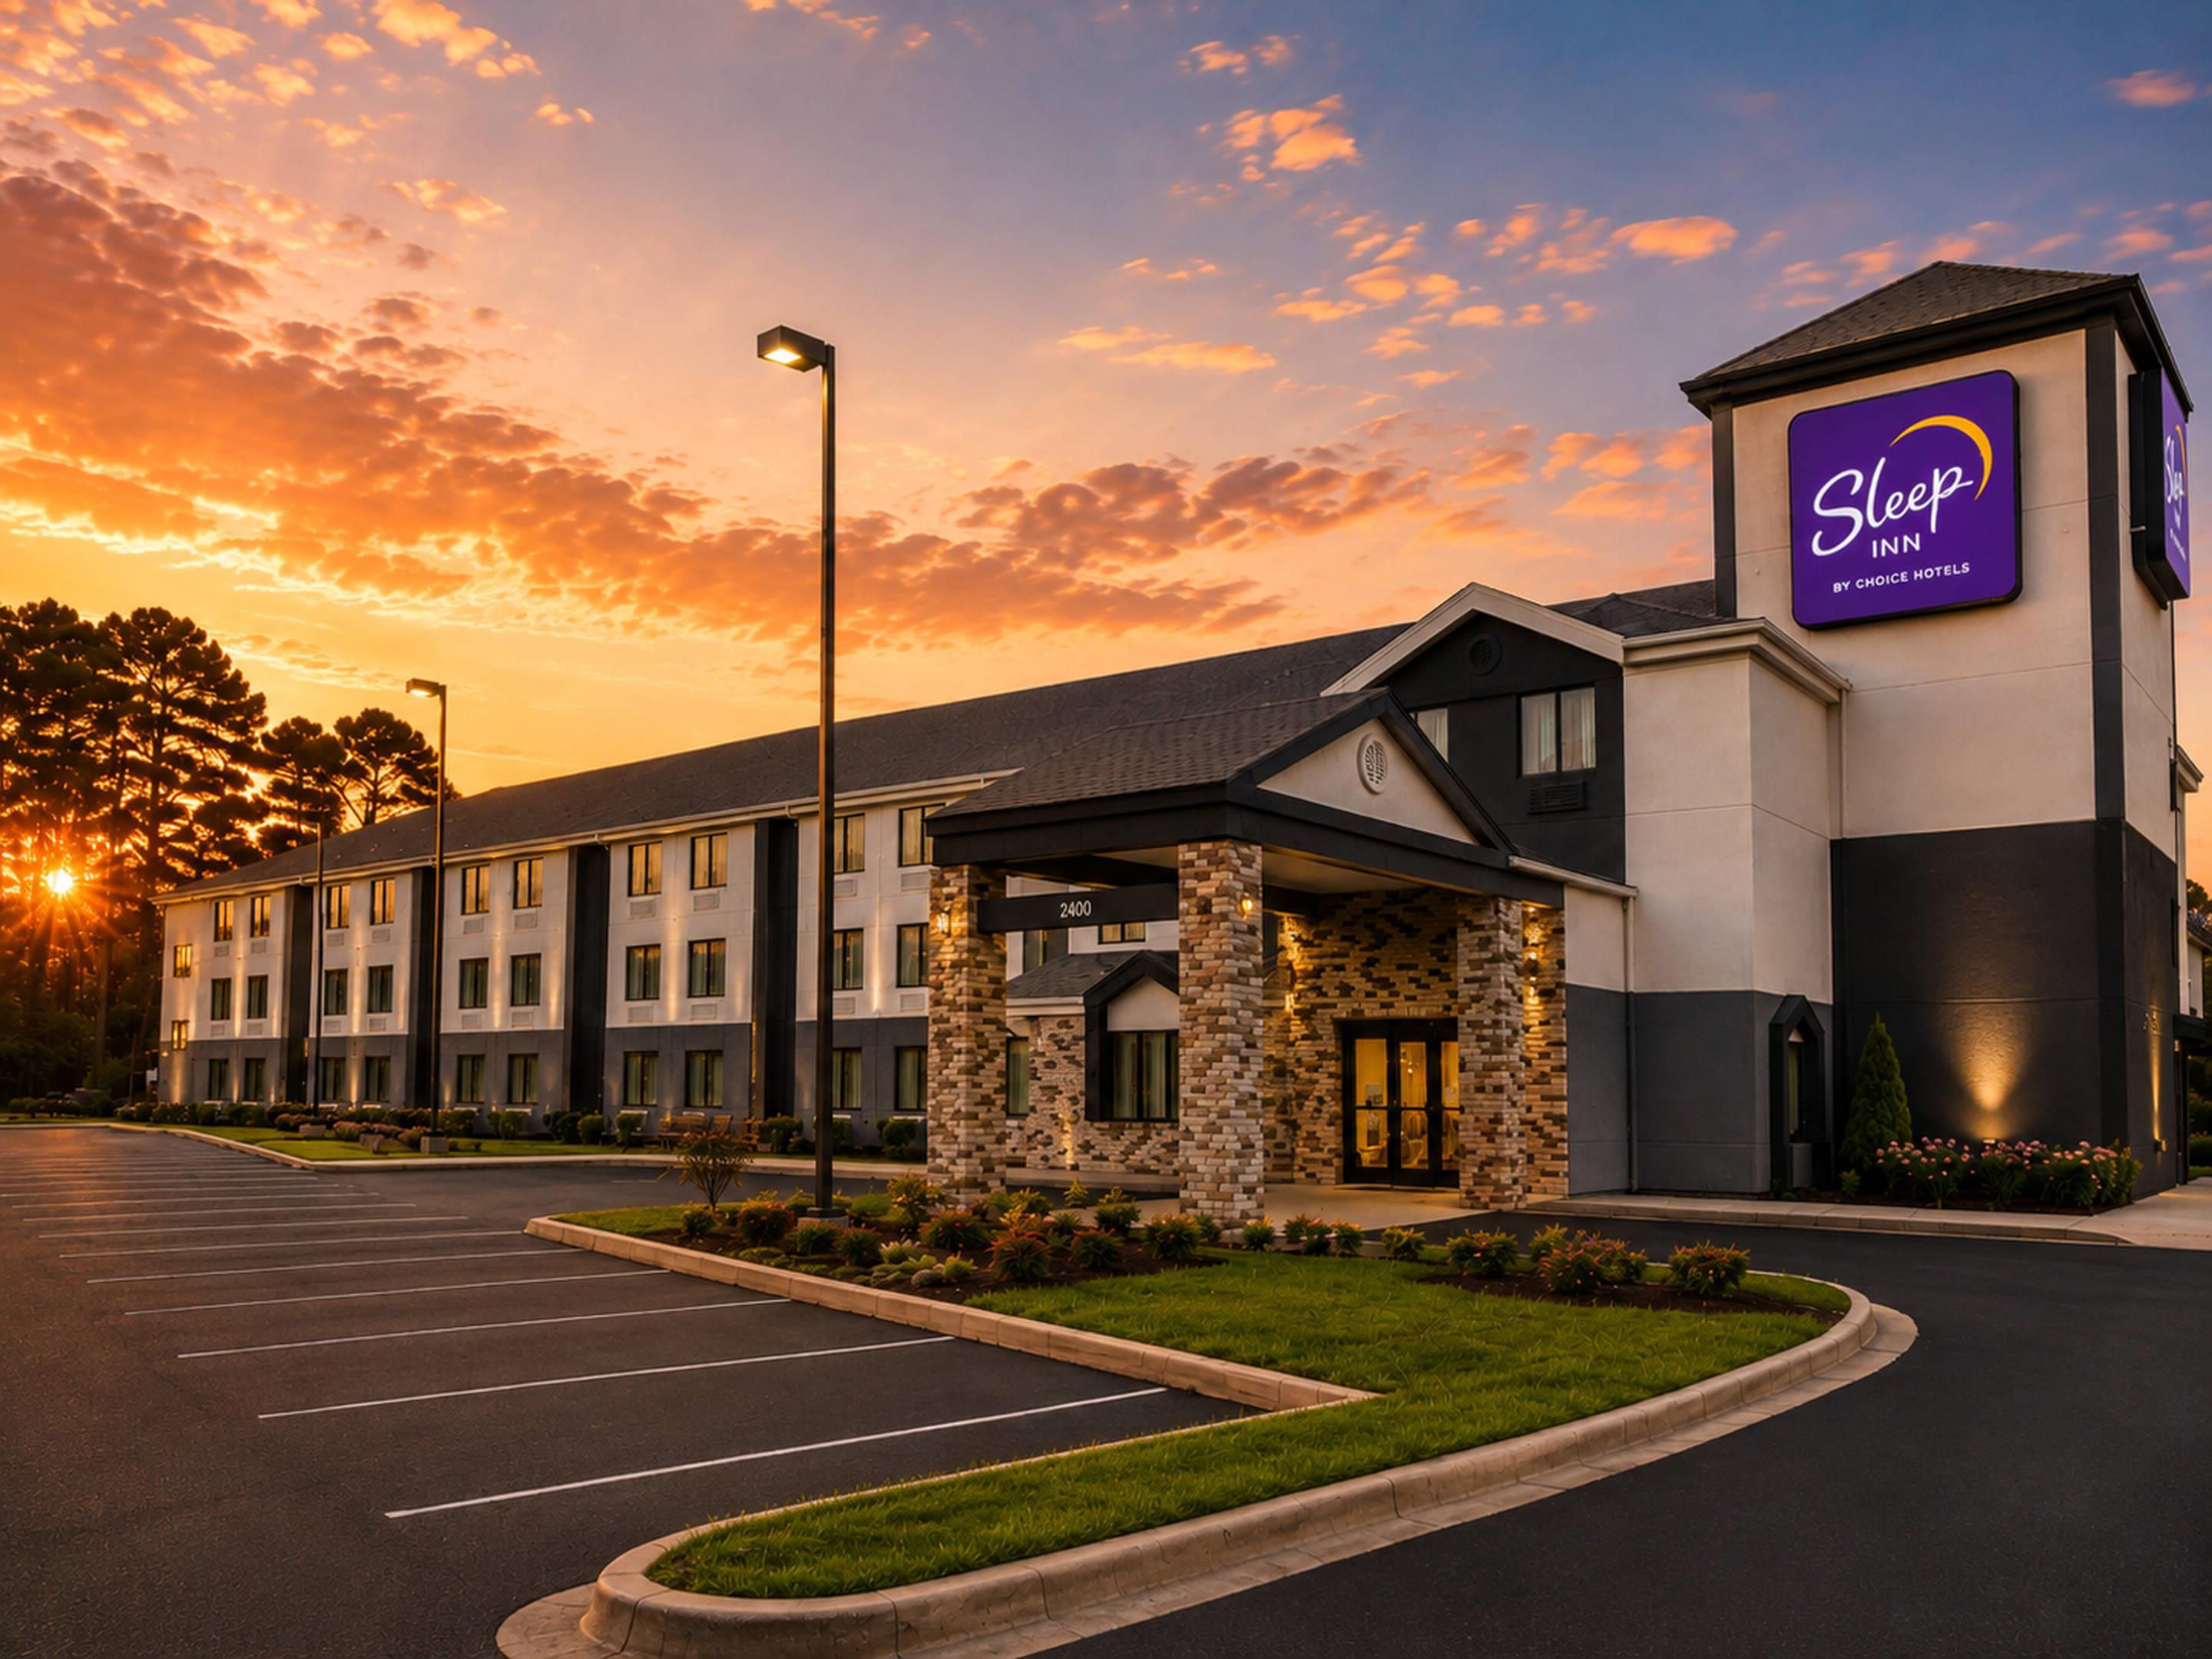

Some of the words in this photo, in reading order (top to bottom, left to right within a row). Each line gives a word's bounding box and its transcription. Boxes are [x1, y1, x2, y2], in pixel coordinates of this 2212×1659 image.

[1812, 458, 1974, 556] Sleep
[1872, 532, 1921, 558] INN
[1833, 581, 1850, 594] BY
[1855, 571, 1909, 590] CHOICE
[1913, 561, 1971, 581] HOTELS
[1060, 899, 1091, 918] 2400
